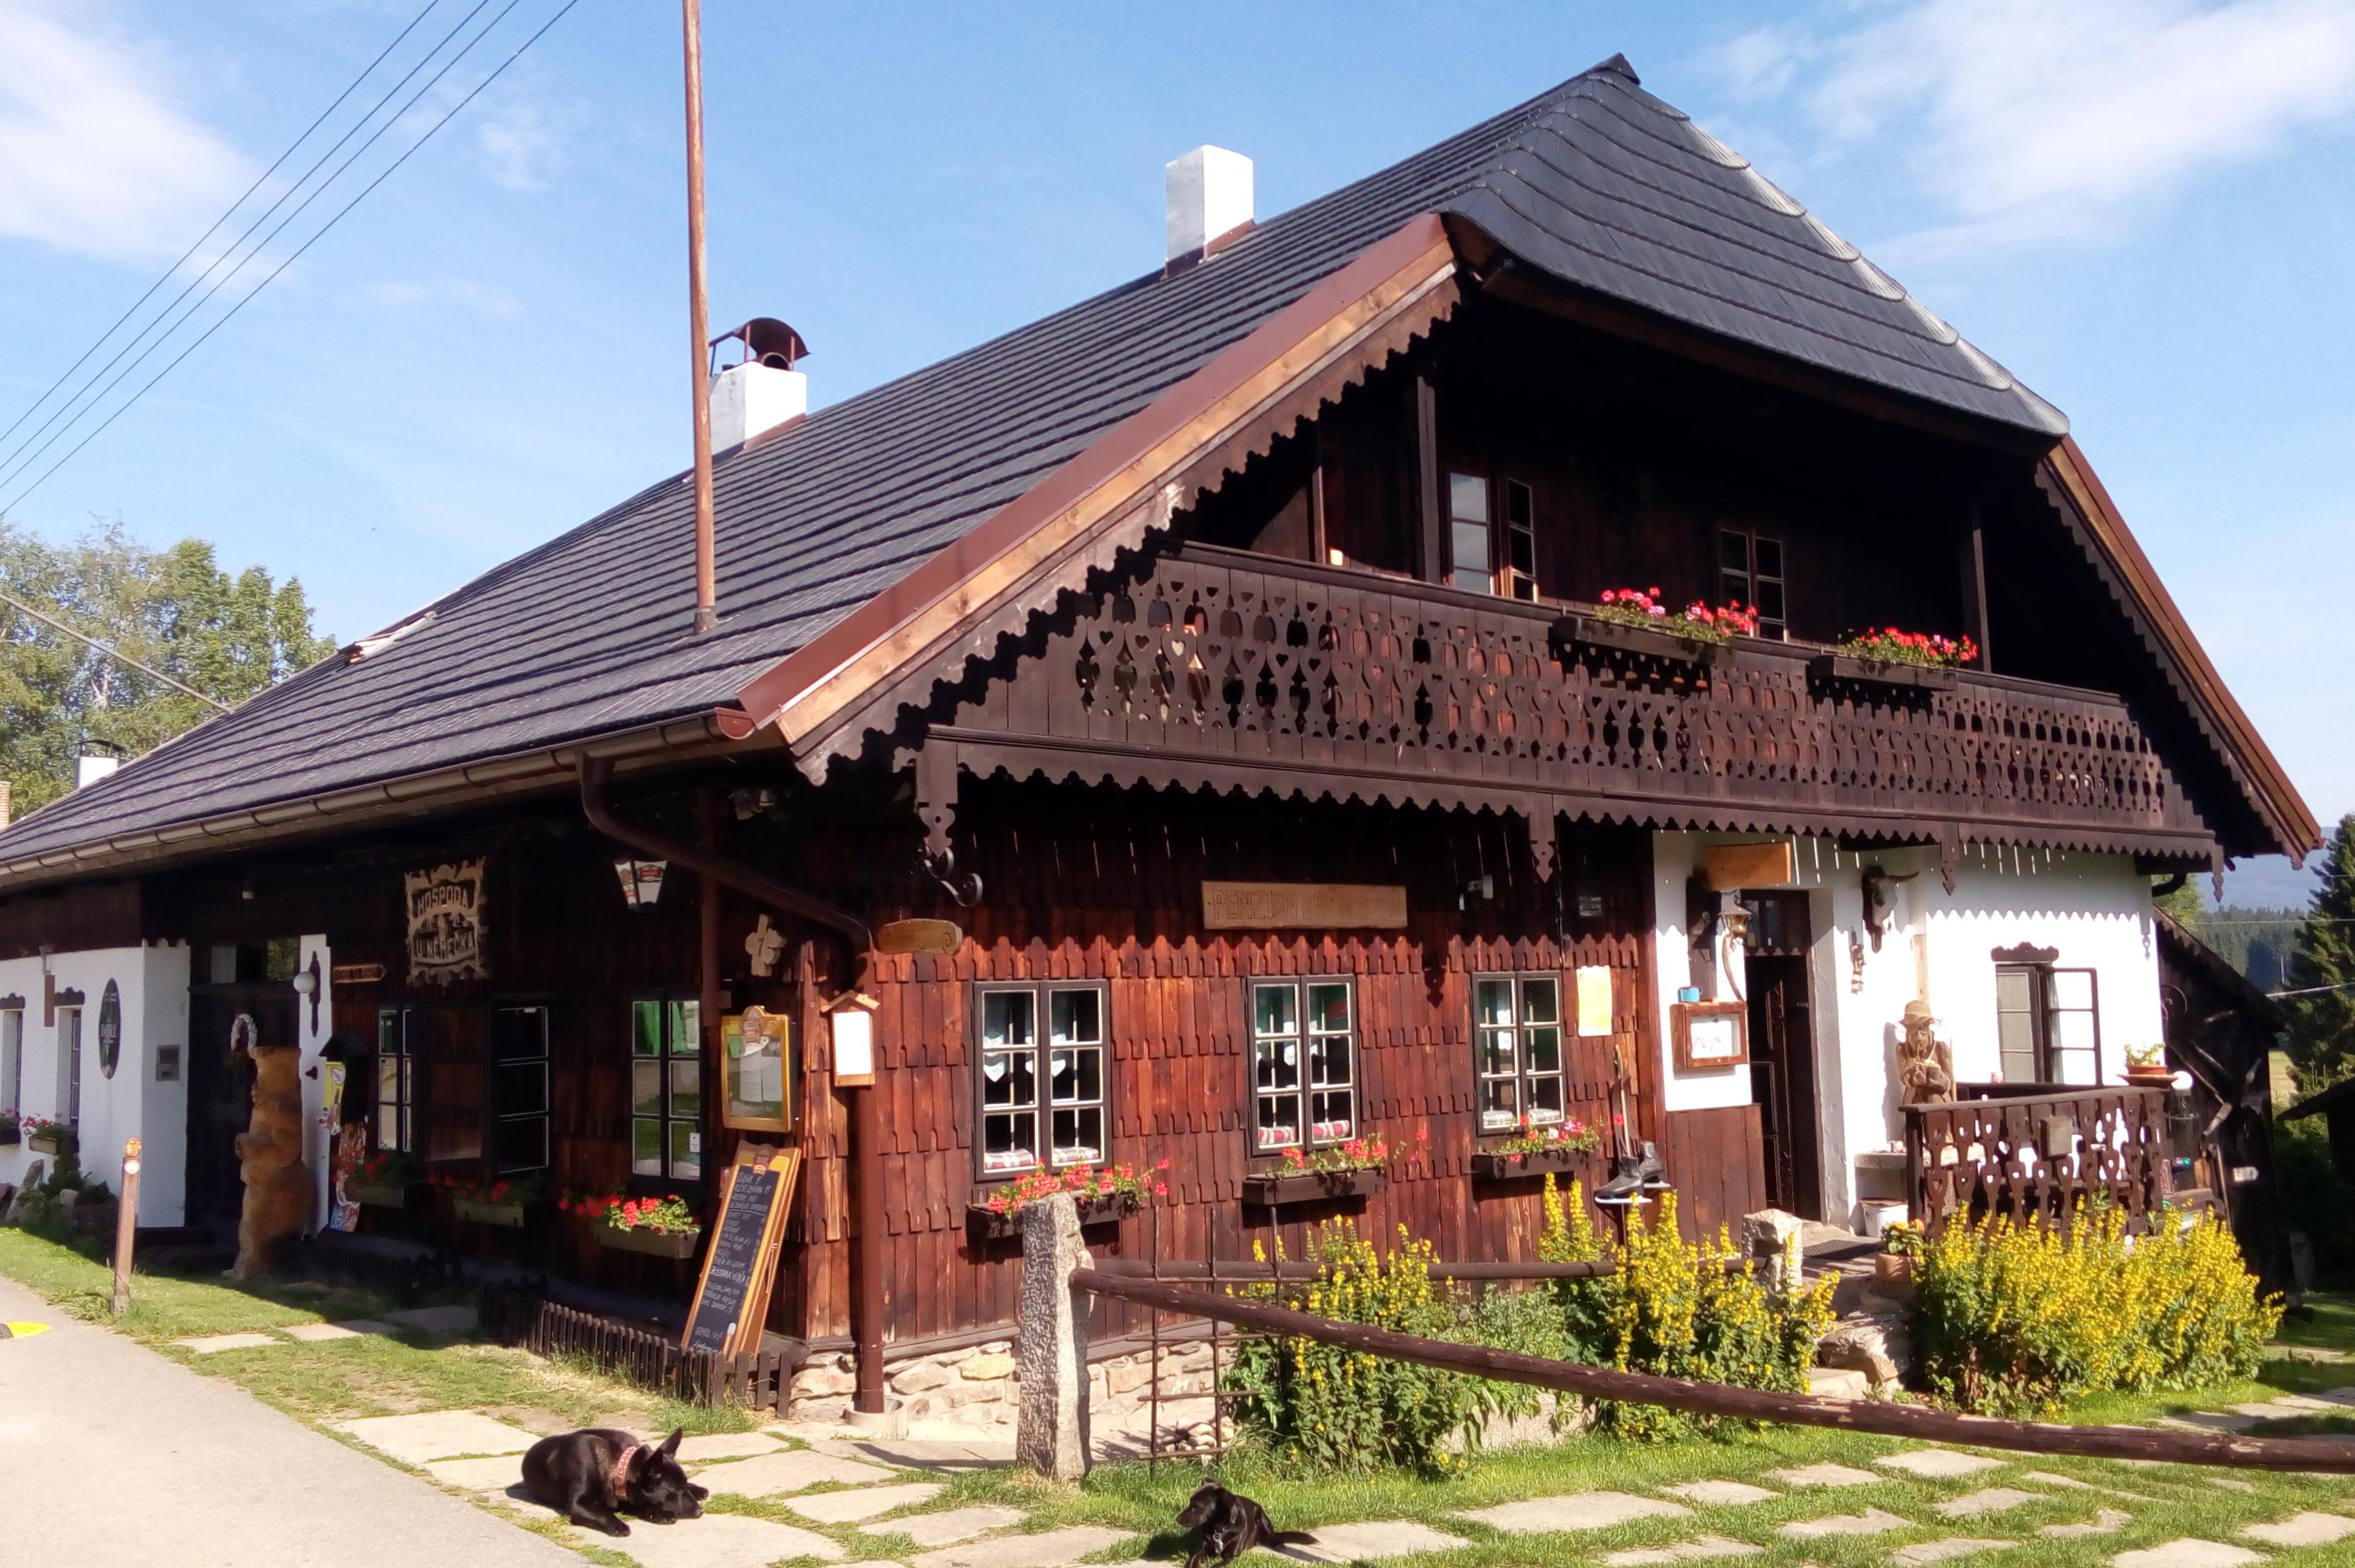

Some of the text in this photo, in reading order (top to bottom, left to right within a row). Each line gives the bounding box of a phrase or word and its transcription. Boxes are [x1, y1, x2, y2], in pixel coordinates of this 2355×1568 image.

[417, 885, 468, 916] HOSPODA
[1212, 889, 1297, 921] PENZION
[416, 938, 423, 956] U
